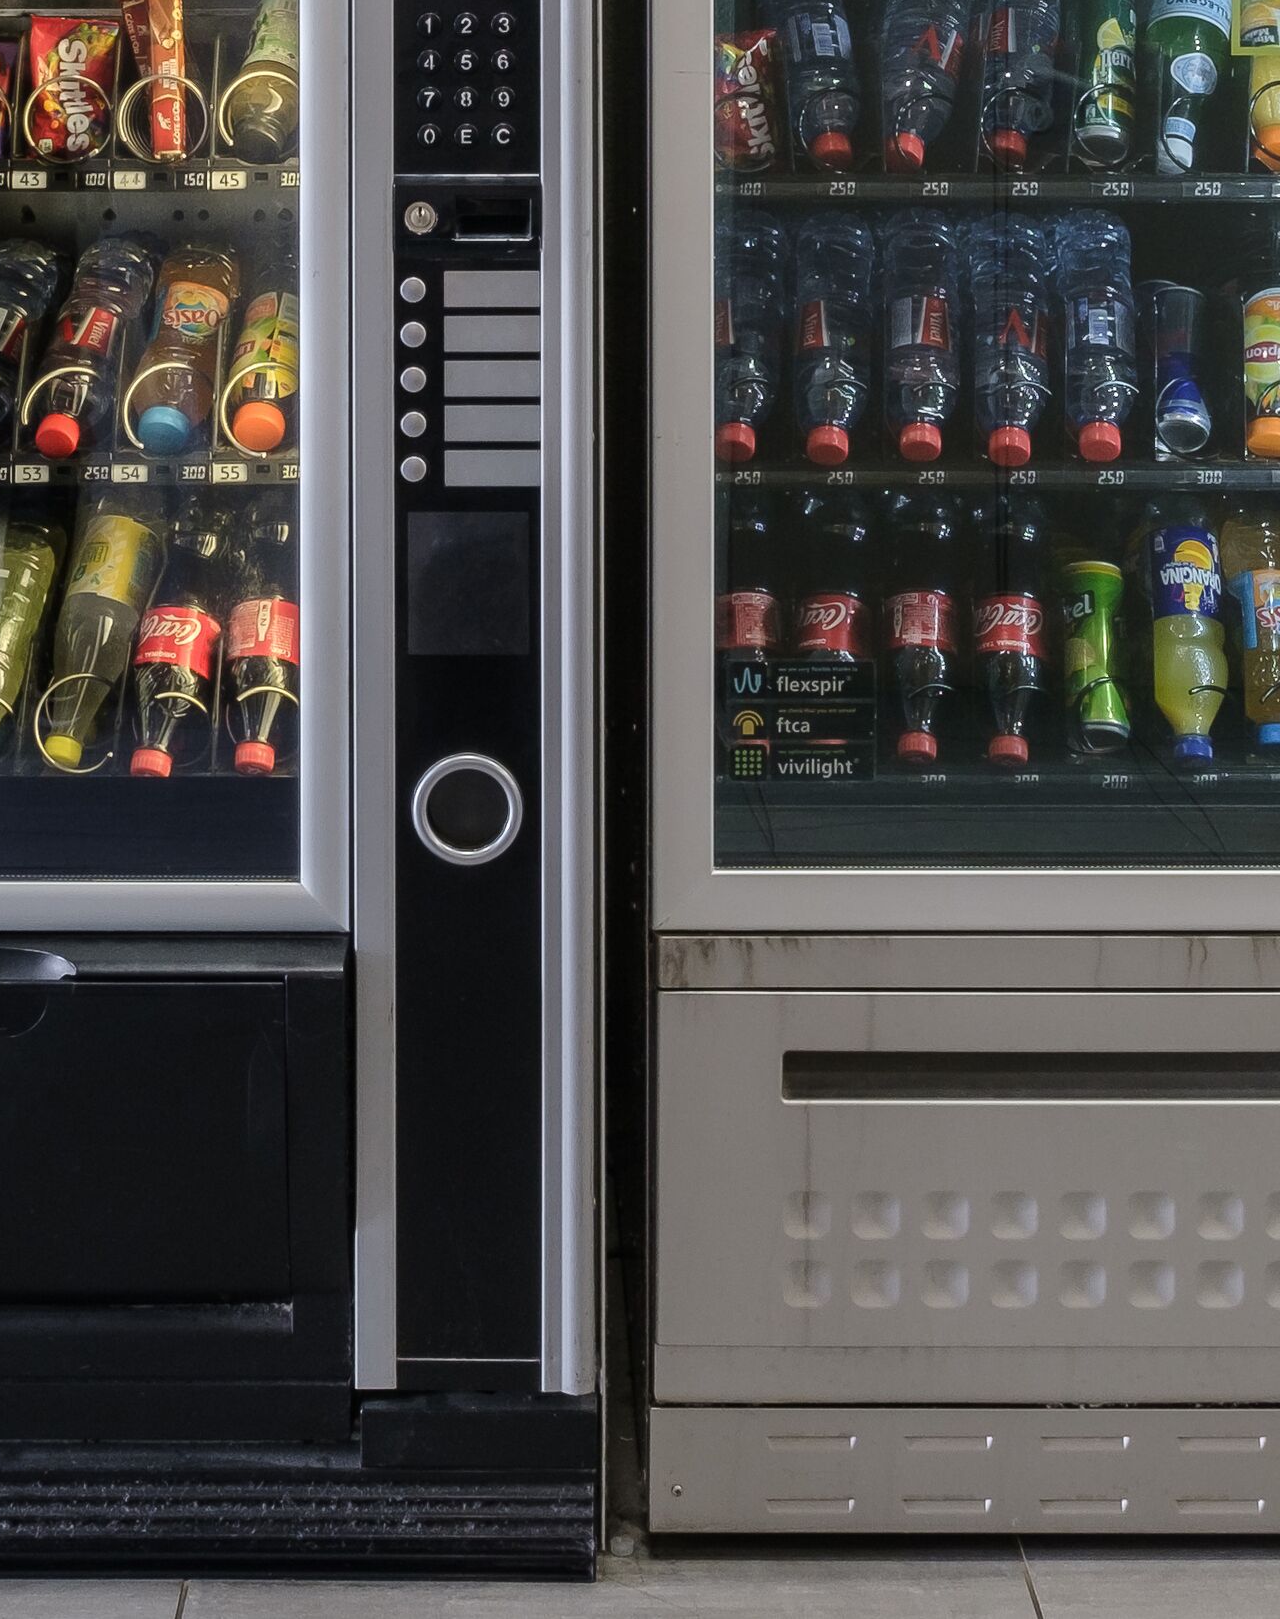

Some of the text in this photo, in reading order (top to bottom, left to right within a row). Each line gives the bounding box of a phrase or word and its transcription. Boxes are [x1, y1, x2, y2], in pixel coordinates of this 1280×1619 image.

[424, 17, 510, 34] 1 2 3
[423, 54, 509, 71] 4 5 6
[57, 38, 91, 152] Skittles
[424, 91, 510, 108] 7 8 9
[423, 128, 511, 145] 0 E C
[20, 173, 40, 185] 43
[219, 173, 239, 186] 45
[164, 306, 220, 328] Oasis
[22, 467, 42, 480] 53
[121, 467, 141, 480] 54
[220, 467, 240, 480] 55
[776, 675, 846, 696] flexspir
[776, 716, 811, 734] ftca
[777, 757, 855, 779] vivilight
